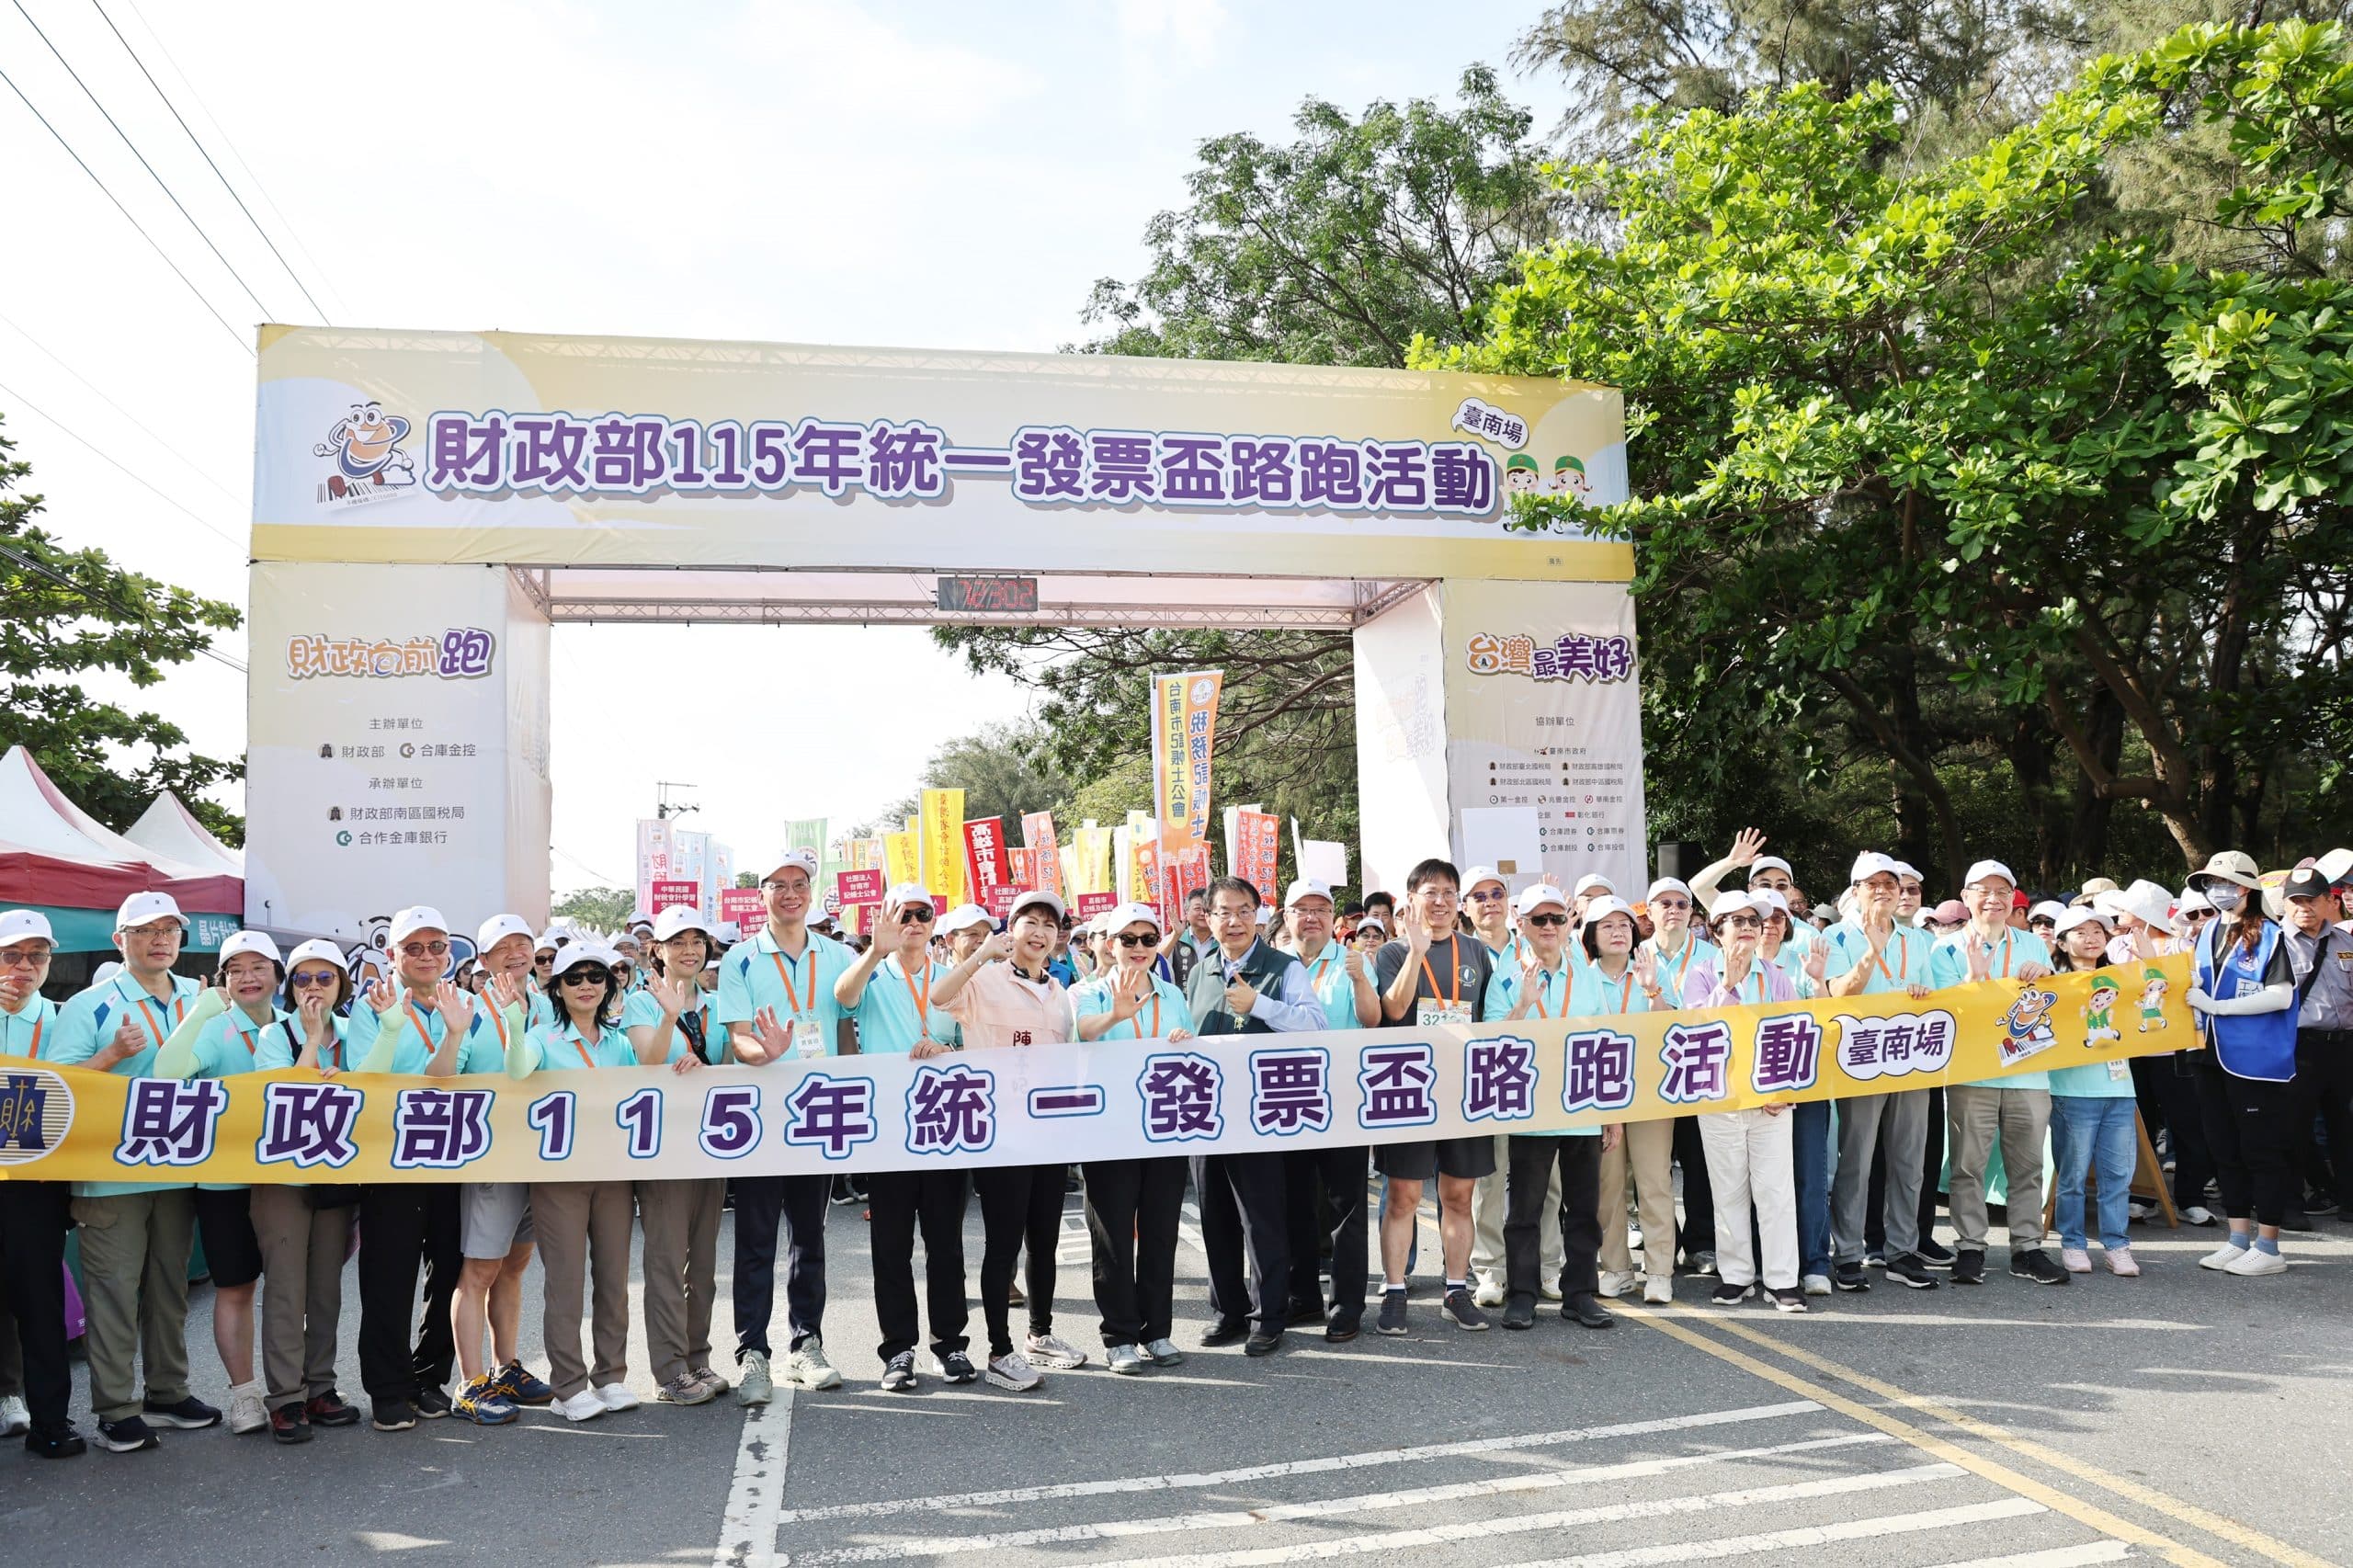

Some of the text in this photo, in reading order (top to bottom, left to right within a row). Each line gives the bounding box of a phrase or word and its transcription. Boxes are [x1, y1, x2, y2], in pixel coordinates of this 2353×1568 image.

[1461, 401, 1524, 444] 臺南場
[429, 417, 1492, 509] 財政部115年統一發票盃路跑活動
[288, 630, 490, 676] 財政向前跑
[1469, 636, 1631, 679] 台灣最美好
[369, 718, 424, 730] 主辦單位
[1535, 716, 1575, 727] 協辦單位
[341, 743, 476, 758] 財政部 合庫金控
[1550, 747, 1586, 756] 臺南市政府
[369, 777, 424, 790] 承辦單位
[1548, 796, 1576, 804] 兆豐金控
[349, 805, 465, 820] 財政部南區國稅局
[1577, 811, 1605, 819] 彰化銀行
[358, 831, 448, 845] 合作金庫銀行
[748, 915, 769, 924] 社團法
[1013, 1029, 1032, 1047] 陳
[1847, 1018, 1947, 1067] 臺南場
[123, 1018, 1819, 1164] 財政部115年統一發票盃路跑活動
